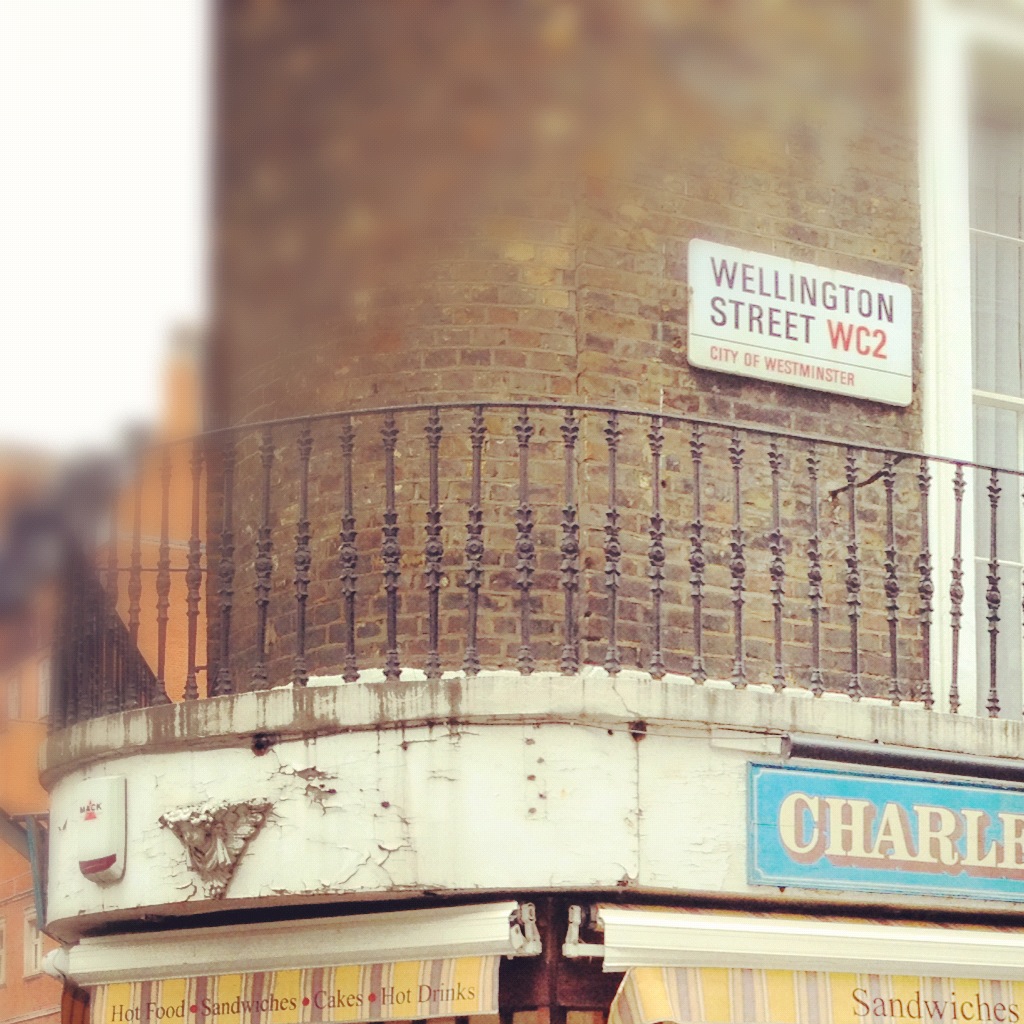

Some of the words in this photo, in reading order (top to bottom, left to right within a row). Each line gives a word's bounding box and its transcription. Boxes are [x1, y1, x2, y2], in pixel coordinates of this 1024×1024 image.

[710, 256, 894, 323] WELLINGTON
[710, 296, 815, 344] STREET
[826, 319, 888, 360] WC2
[710, 345, 739, 364] CITY
[744, 353, 761, 368] OF
[764, 356, 855, 386] WESTMINSTER
[111, 1004, 142, 1024] Hot
[146, 1000, 186, 1020] Food
[200, 993, 298, 1018] Sandwiches
[314, 989, 364, 1011] Cakes
[381, 985, 412, 1006] Hot
[418, 981, 476, 1004] Drinks
[852, 987, 1020, 1024] Sandwiches
